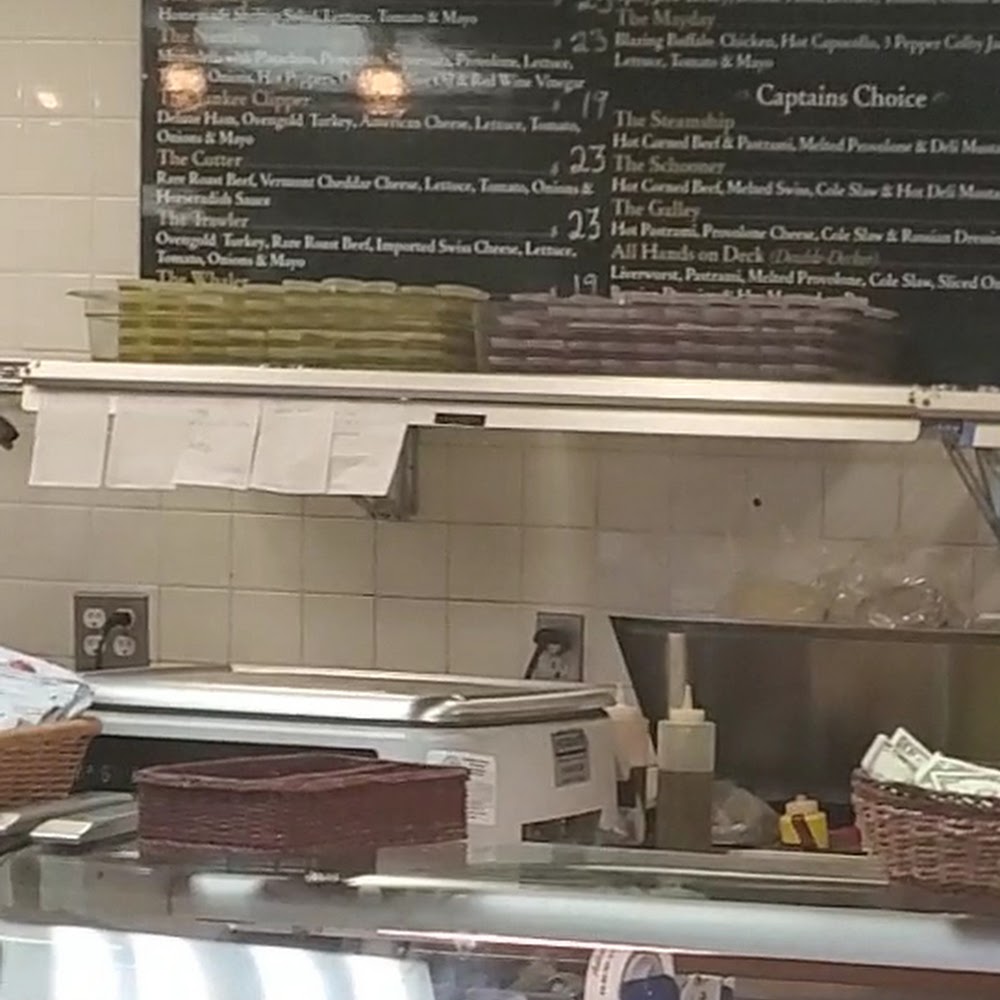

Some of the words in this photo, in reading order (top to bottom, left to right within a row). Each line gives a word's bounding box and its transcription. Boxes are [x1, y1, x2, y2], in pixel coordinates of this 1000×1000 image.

[570, 29, 608, 52] 23
[756, 83, 848, 114] Captains
[853, 84, 928, 108] Choice
[424, 114, 473, 131] Cheese,
[157, 129, 203, 144] Onions
[205, 131, 216, 144] &
[219, 131, 255, 148] Mayo
[613, 133, 639, 149] Hot
[915, 139, 927, 153] &
[159, 149, 188, 166] The
[191, 150, 243, 167] Cutter
[570, 145, 606, 173] 23
[156, 171, 185, 186] Rare
[374, 175, 422, 191] Cheese,
[582, 181, 594, 195] &
[612, 177, 638, 192] Hot
[881, 184, 893, 197] &
[897, 184, 923, 198] Hot
[613, 199, 643, 217] The
[568, 207, 601, 240] 23
[611, 221, 637, 237] Hot
[886, 228, 898, 243] &
[272, 234, 302, 249] Rare
[376, 237, 437, 257] Imported
[439, 239, 472, 254] Swiss
[474, 240, 522, 256] Cheese,
[612, 243, 636, 260] All
[641, 243, 694, 261] Hands
[698, 248, 718, 261] on
[723, 245, 764, 263] Deck
[157, 250, 206, 267] Tomato,
[208, 251, 253, 267] Onions
[256, 253, 267, 267] &
[270, 253, 306, 271] Mayo
[869, 272, 899, 287] Cole
